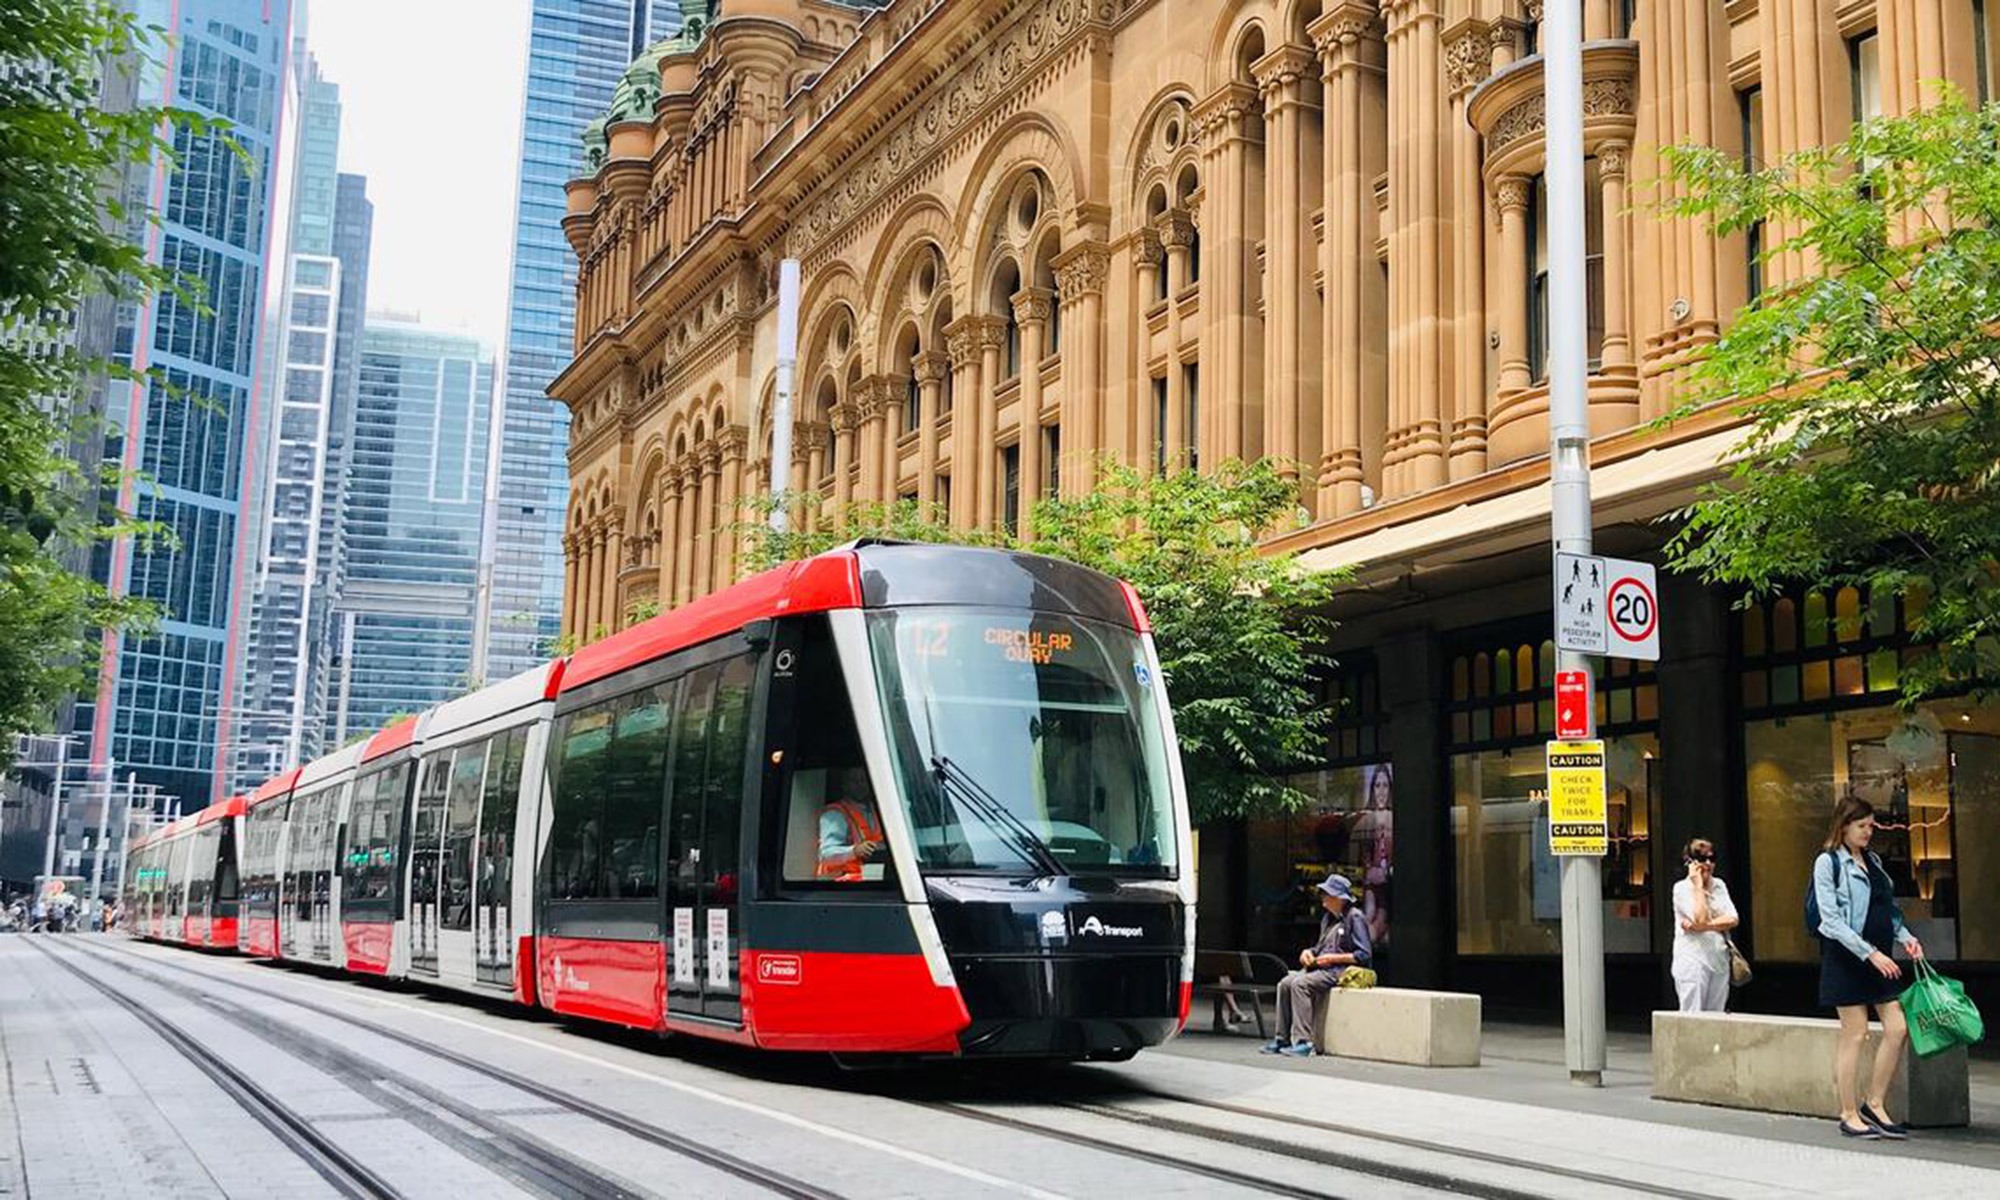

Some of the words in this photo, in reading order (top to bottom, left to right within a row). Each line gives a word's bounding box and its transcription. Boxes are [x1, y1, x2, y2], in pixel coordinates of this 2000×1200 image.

[1615, 593, 1648, 626] 20
[983, 627, 1073, 650] CIRCULAR
[1568, 637, 1597, 645] ACTIVITY
[1005, 646, 1053, 664] QUAY
[1551, 756, 1601, 766] CAUTION
[1560, 776, 1592, 784] CHECK
[1562, 787, 1591, 795] TWICE
[1567, 798, 1587, 806] FOR
[1561, 809, 1594, 817] TRAMS
[1553, 826, 1603, 836] CAUTION
[1103, 925, 1144, 938] Transport
